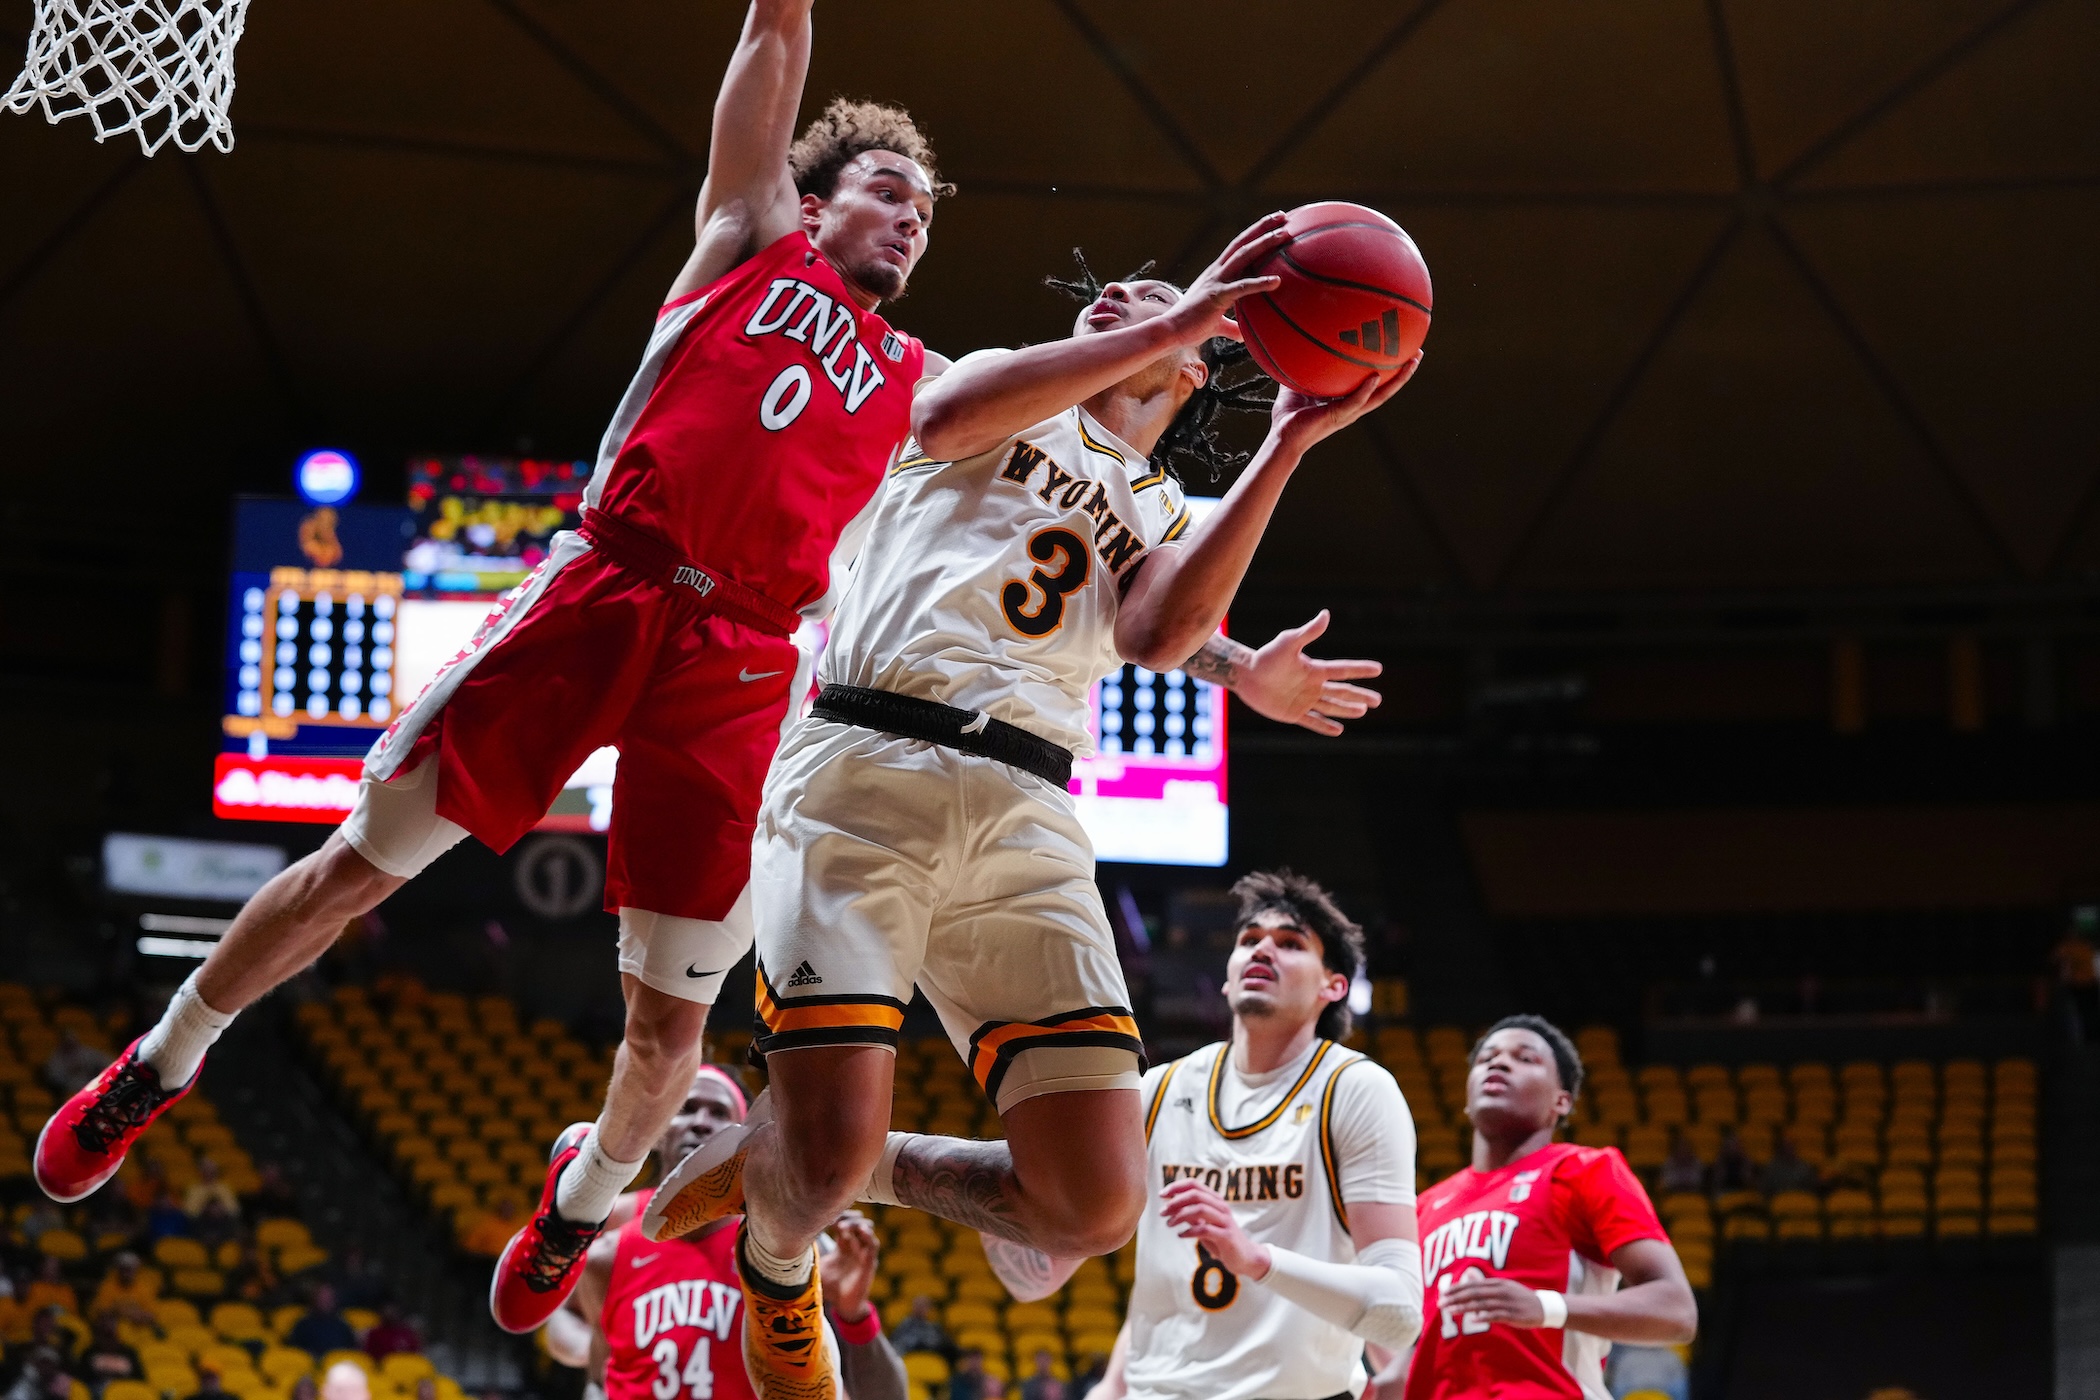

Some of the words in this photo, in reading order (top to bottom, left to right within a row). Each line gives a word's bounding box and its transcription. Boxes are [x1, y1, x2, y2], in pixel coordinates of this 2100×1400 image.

[744, 278, 886, 415] UNLV
[759, 363, 813, 432] 0
[672, 565, 716, 598] UNLV
[999, 526, 1091, 638] 3
[788, 974, 822, 987] adidas
[1423, 1209, 1520, 1288] UNLV
[633, 1279, 742, 1350] UNLV
[653, 1337, 715, 1400] 34
